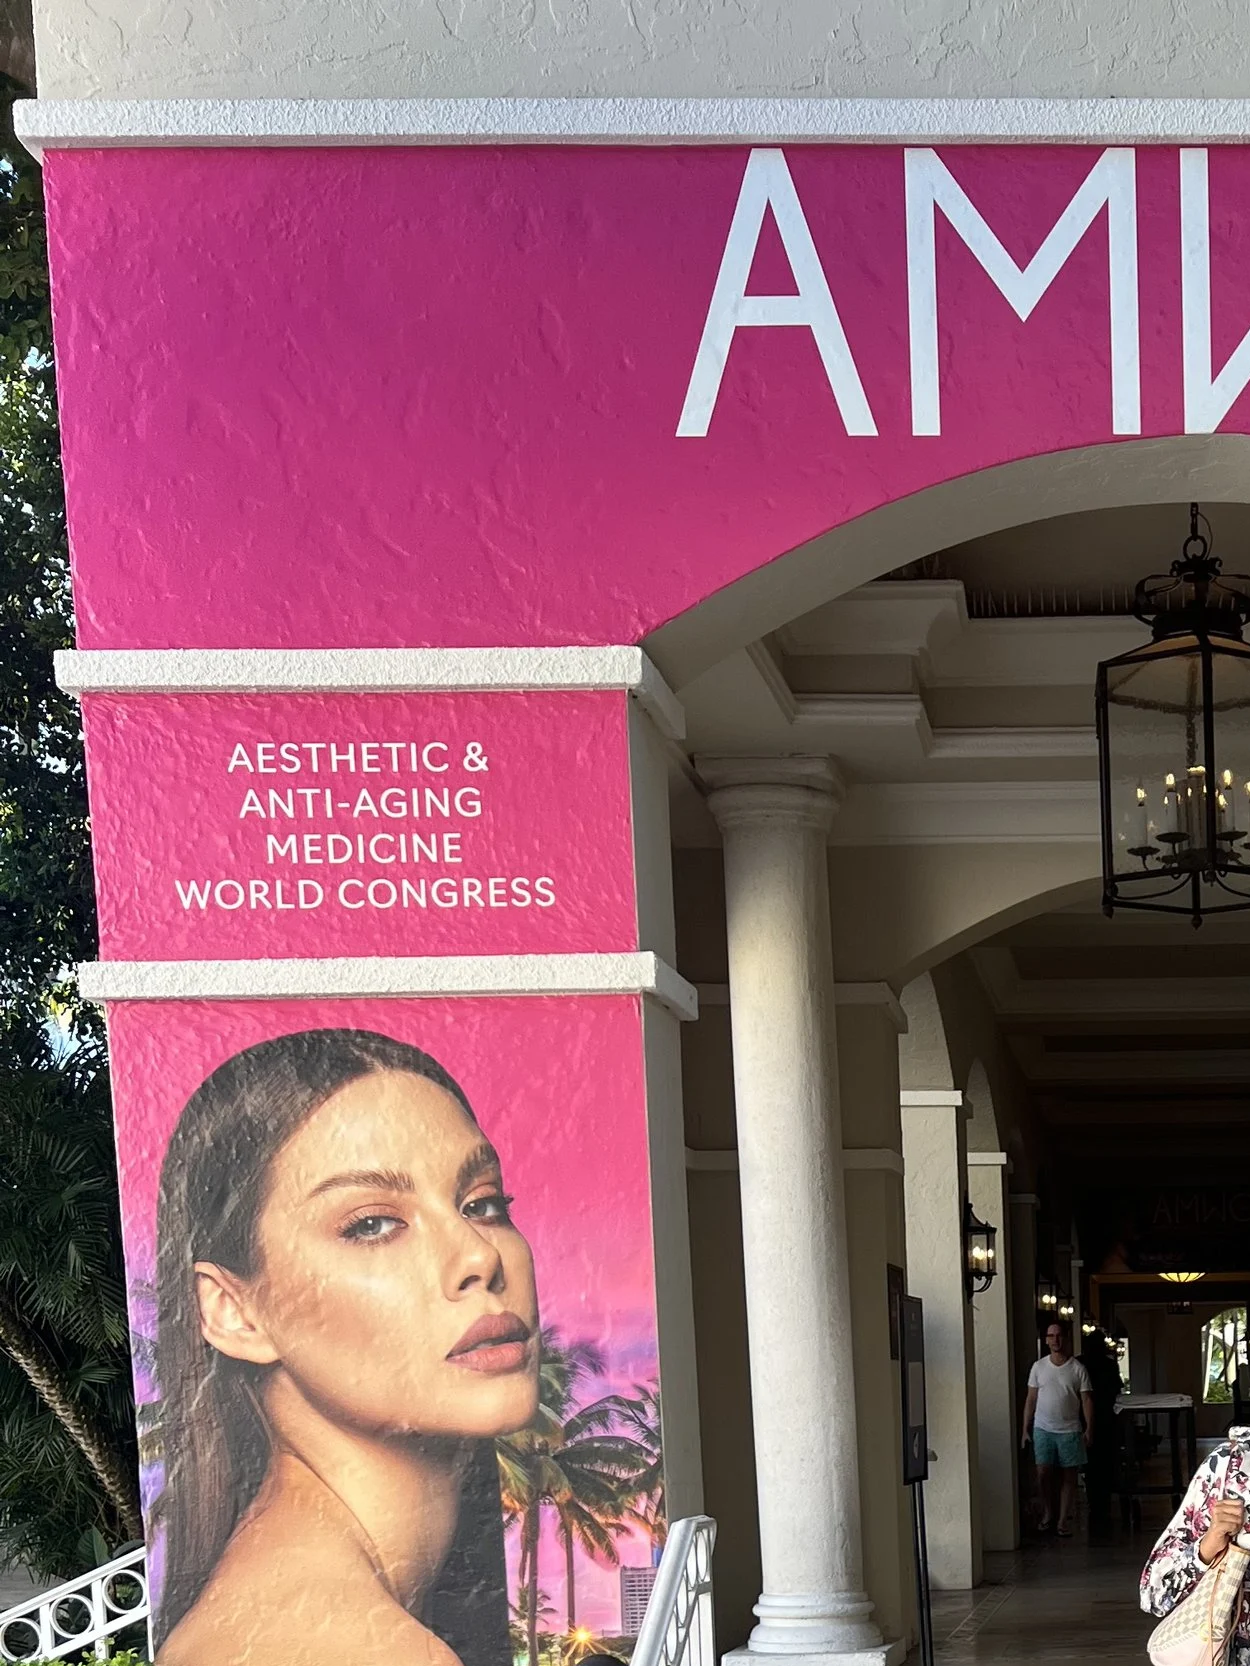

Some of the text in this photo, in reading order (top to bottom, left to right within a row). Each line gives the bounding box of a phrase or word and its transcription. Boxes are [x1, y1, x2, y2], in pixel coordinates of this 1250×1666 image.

[228, 741, 489, 774] AESTHETIC &
[239, 786, 482, 819] ANTI-AGING
[266, 832, 463, 864] MEDICINE
[175, 876, 556, 911] WORLD CONGRESS
